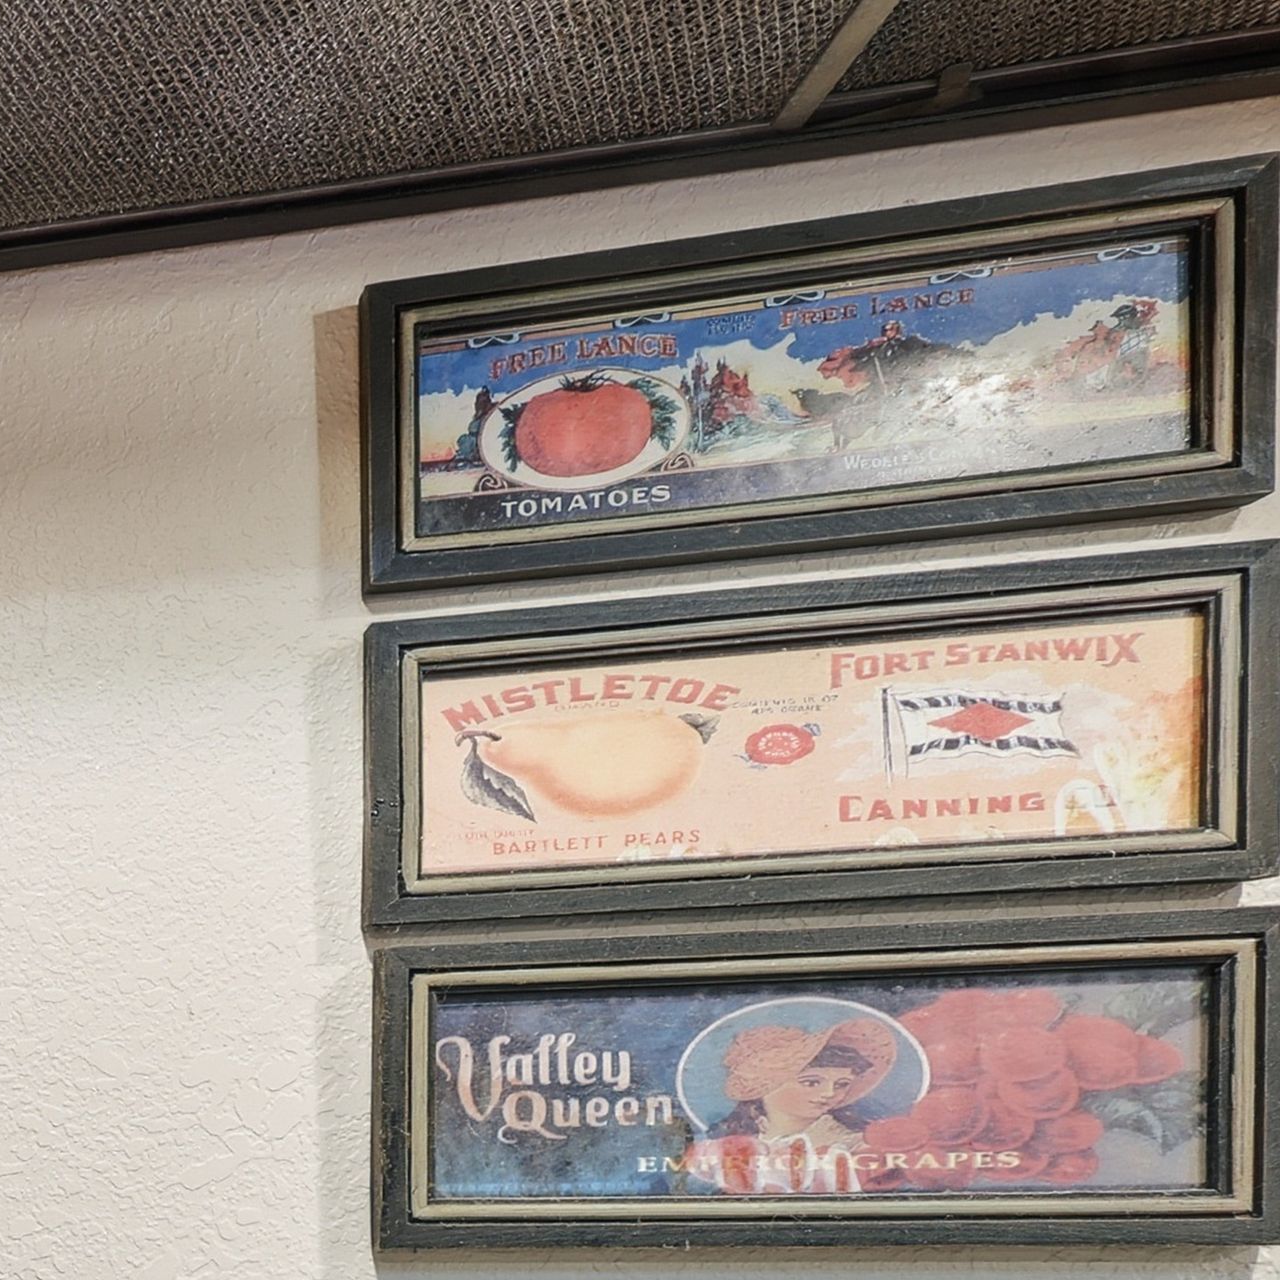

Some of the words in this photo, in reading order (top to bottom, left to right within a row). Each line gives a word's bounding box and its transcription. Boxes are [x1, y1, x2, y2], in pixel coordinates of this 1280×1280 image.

[779, 304, 858, 330] FREE
[871, 288, 975, 316] LANCE
[490, 342, 567, 380] FREE
[577, 333, 679, 360] LANCE
[501, 485, 671, 518] TOMATOES
[830, 650, 935, 689] FORT
[944, 632, 1144, 667] STANWIX
[440, 674, 740, 733] MISTLETOE
[838, 791, 1046, 823] CANNING
[493, 834, 608, 856] BARTLETT
[624, 829, 701, 847] PEARS
[435, 1033, 631, 1122] Valley
[498, 1090, 674, 1144] Queen
[855, 1151, 1022, 1170] GRAPES
